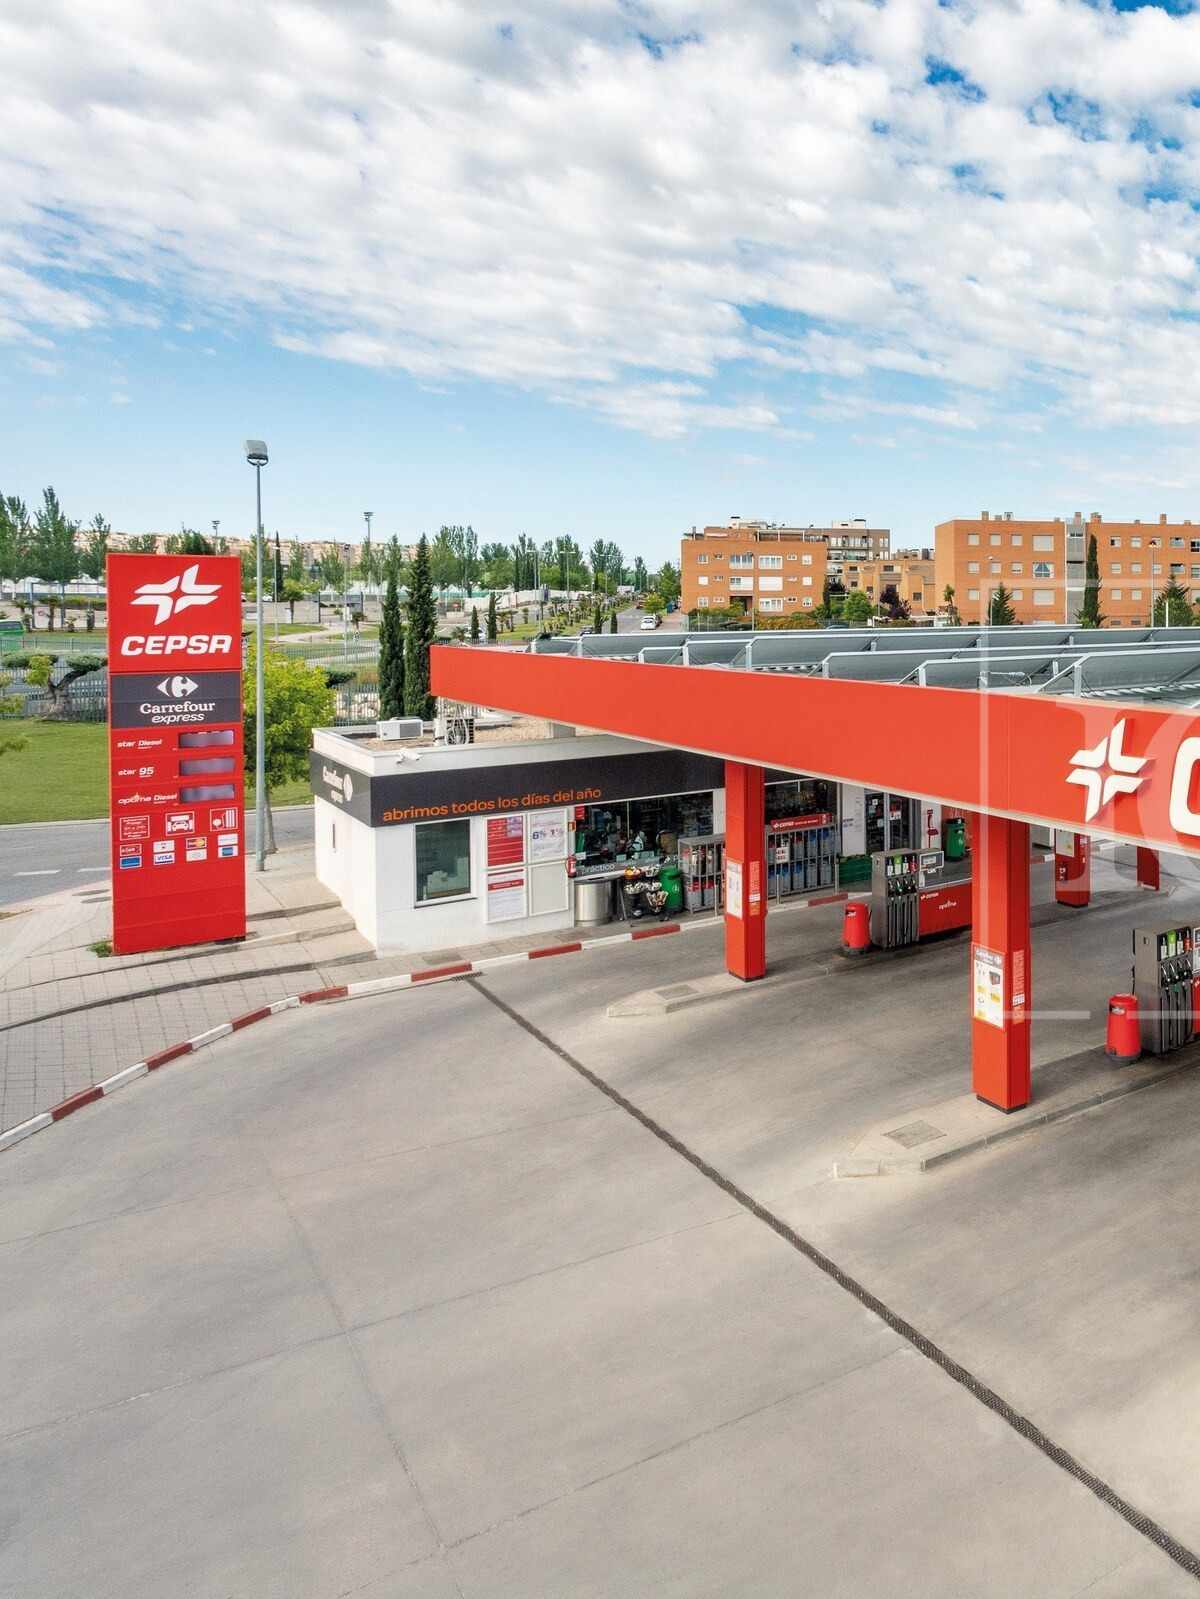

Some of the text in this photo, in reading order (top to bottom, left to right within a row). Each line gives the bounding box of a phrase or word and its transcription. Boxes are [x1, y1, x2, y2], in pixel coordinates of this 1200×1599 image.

[120, 634, 233, 656] CEPSA
[139, 700, 216, 715] Carrefour
[151, 712, 205, 725] express
[117, 740, 136, 748] star
[138, 739, 163, 747] Diesel
[138, 766, 155, 776] 95
[118, 794, 152, 805] optima
[153, 793, 178, 801] Diesel
[382, 787, 602, 822] abrimos todos los días del año
[581, 863, 615, 875] práctico
